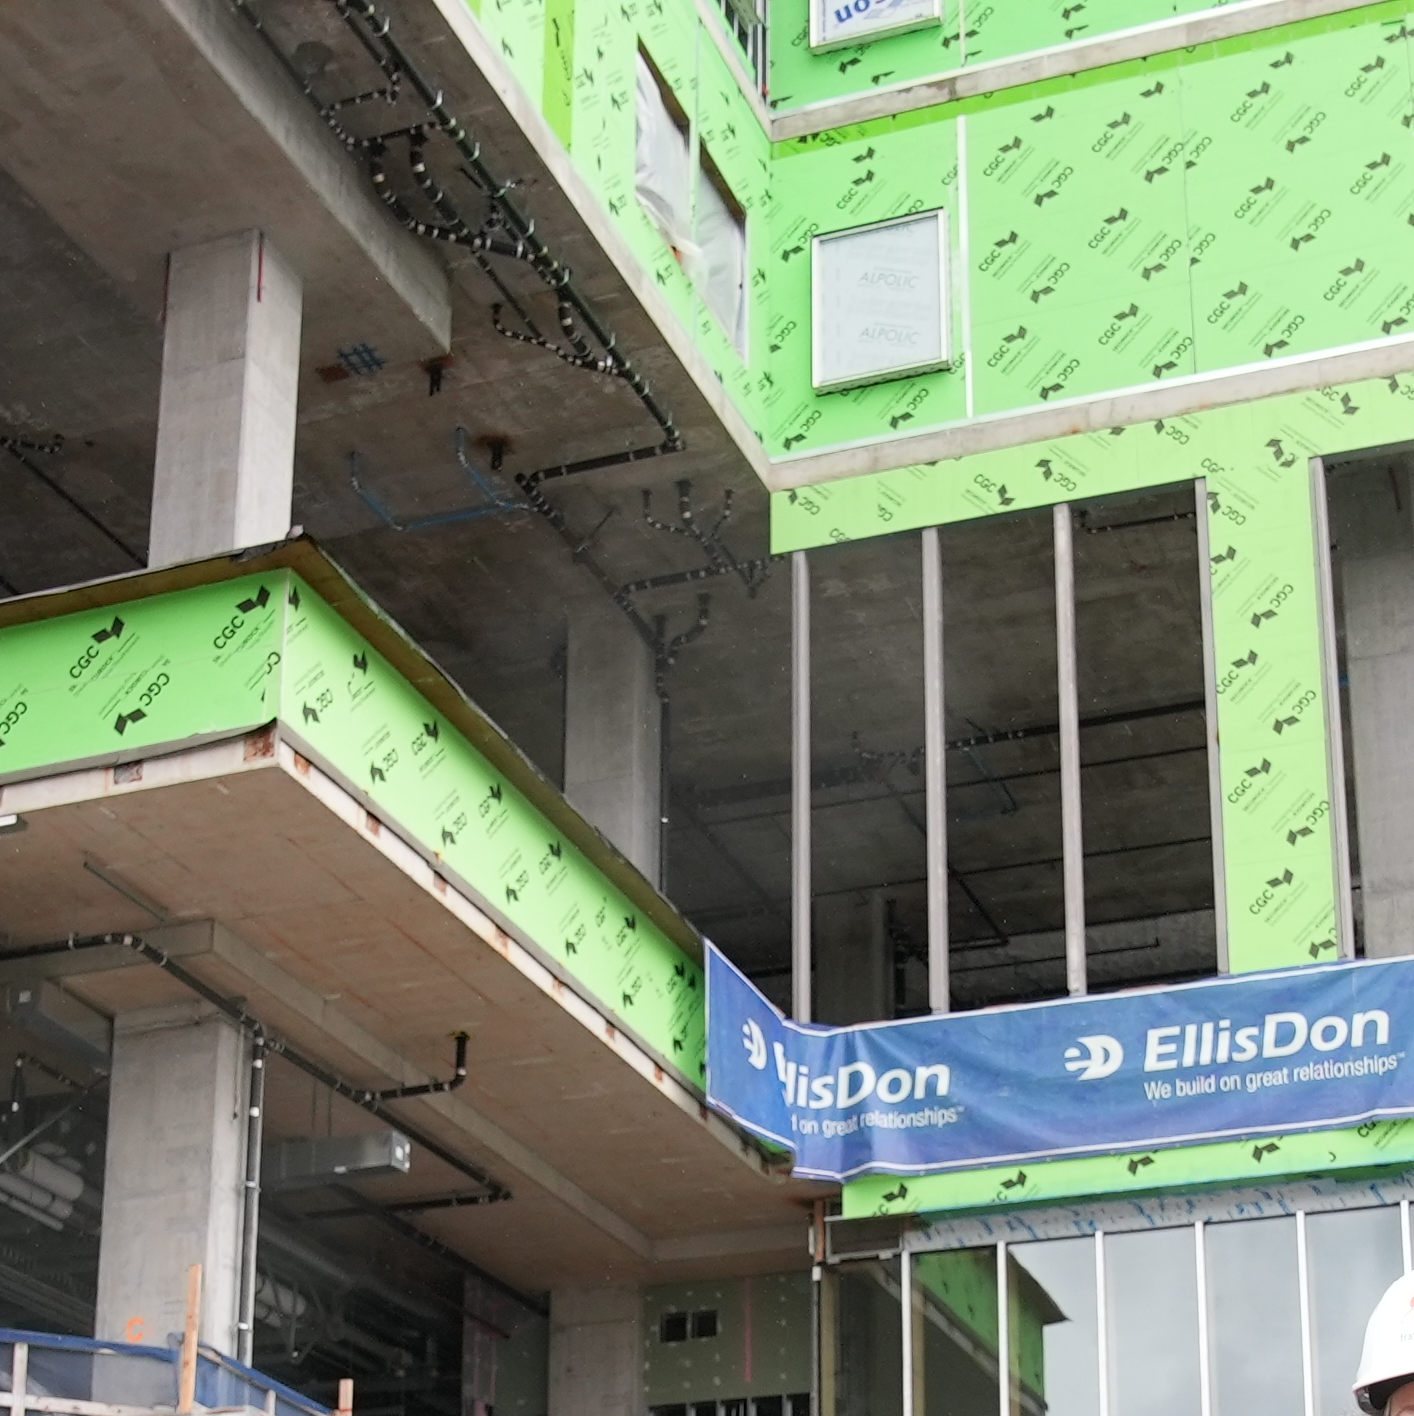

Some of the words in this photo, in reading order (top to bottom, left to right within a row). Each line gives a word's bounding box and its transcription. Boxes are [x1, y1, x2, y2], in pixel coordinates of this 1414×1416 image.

[1143, 1008, 1390, 1072] EllisDon
[1144, 1081, 1172, 1100] We
[1176, 1074, 1216, 1097] build
[1220, 1073, 1241, 1092] on
[1246, 1067, 1289, 1093] great
